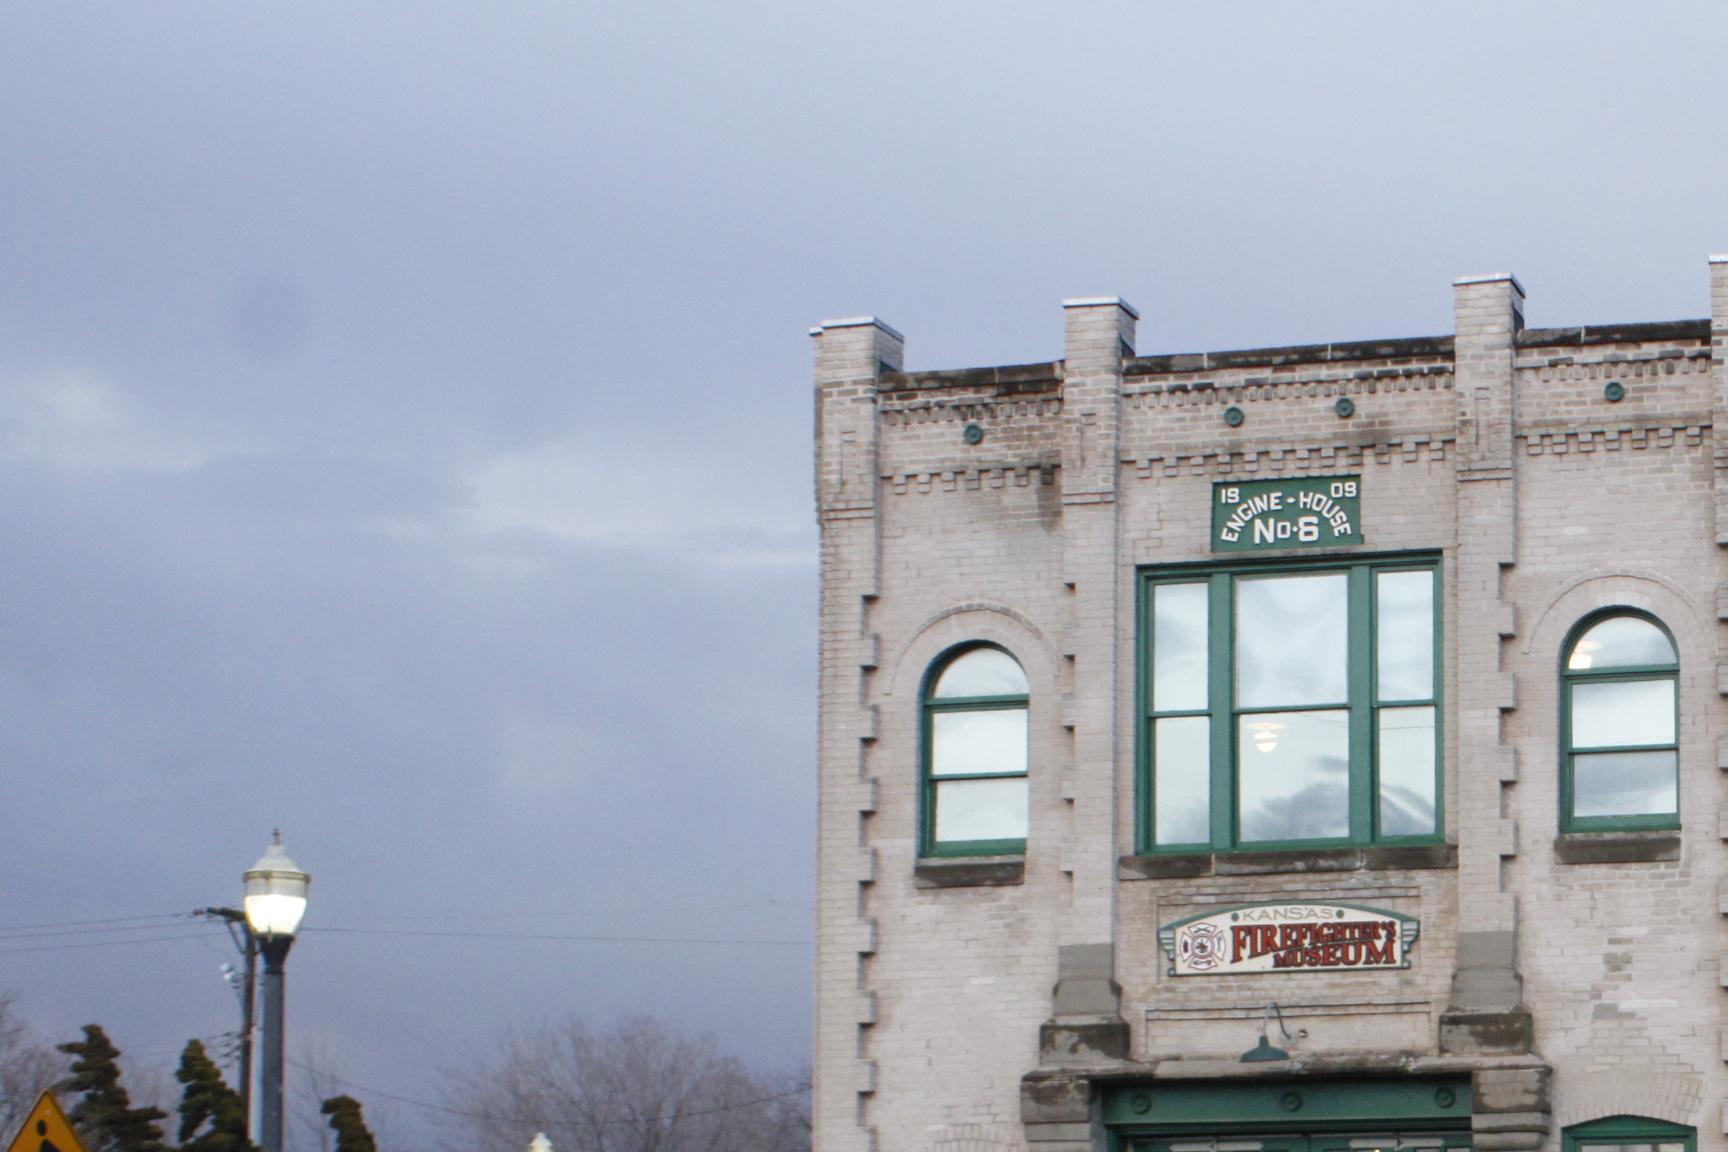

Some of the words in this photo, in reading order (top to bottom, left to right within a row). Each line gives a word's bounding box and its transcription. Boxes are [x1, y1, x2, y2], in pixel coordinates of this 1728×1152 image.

[1221, 488, 1240, 504] 19
[1330, 482, 1357, 498] 09
[1221, 492, 1283, 543] ENGINE
[1299, 491, 1352, 537] HOUSE
[1230, 920, 1396, 964] FIREFIGHTER'S
[1272, 939, 1396, 969] MUSEUM
